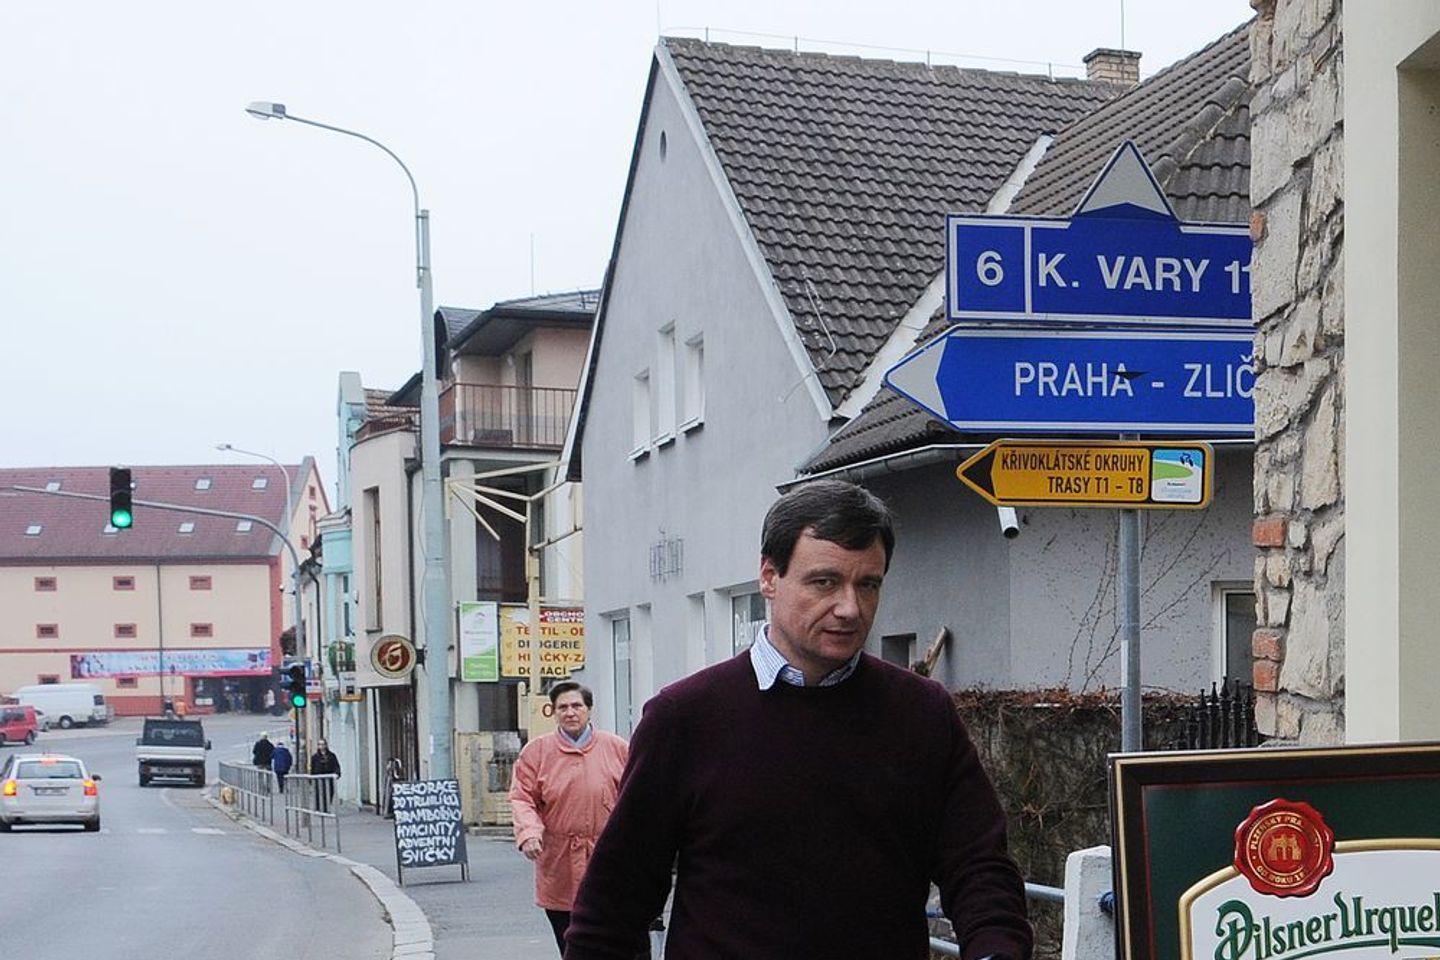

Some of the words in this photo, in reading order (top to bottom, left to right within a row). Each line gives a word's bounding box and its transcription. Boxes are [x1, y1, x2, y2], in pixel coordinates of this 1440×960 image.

[975, 250, 1004, 287] 6
[1037, 253, 1079, 288] K.
[1097, 255, 1209, 293] VARY
[1014, 361, 1133, 398] PRAHA
[1002, 450, 1091, 471] KŘIVOKLÁTSKÉ
[1094, 453, 1144, 472] OKRUHY
[1048, 476, 1090, 494] TRASY
[1095, 477, 1109, 494] T1
[1128, 477, 1144, 494] T8
[517, 626, 558, 636] TETIL
